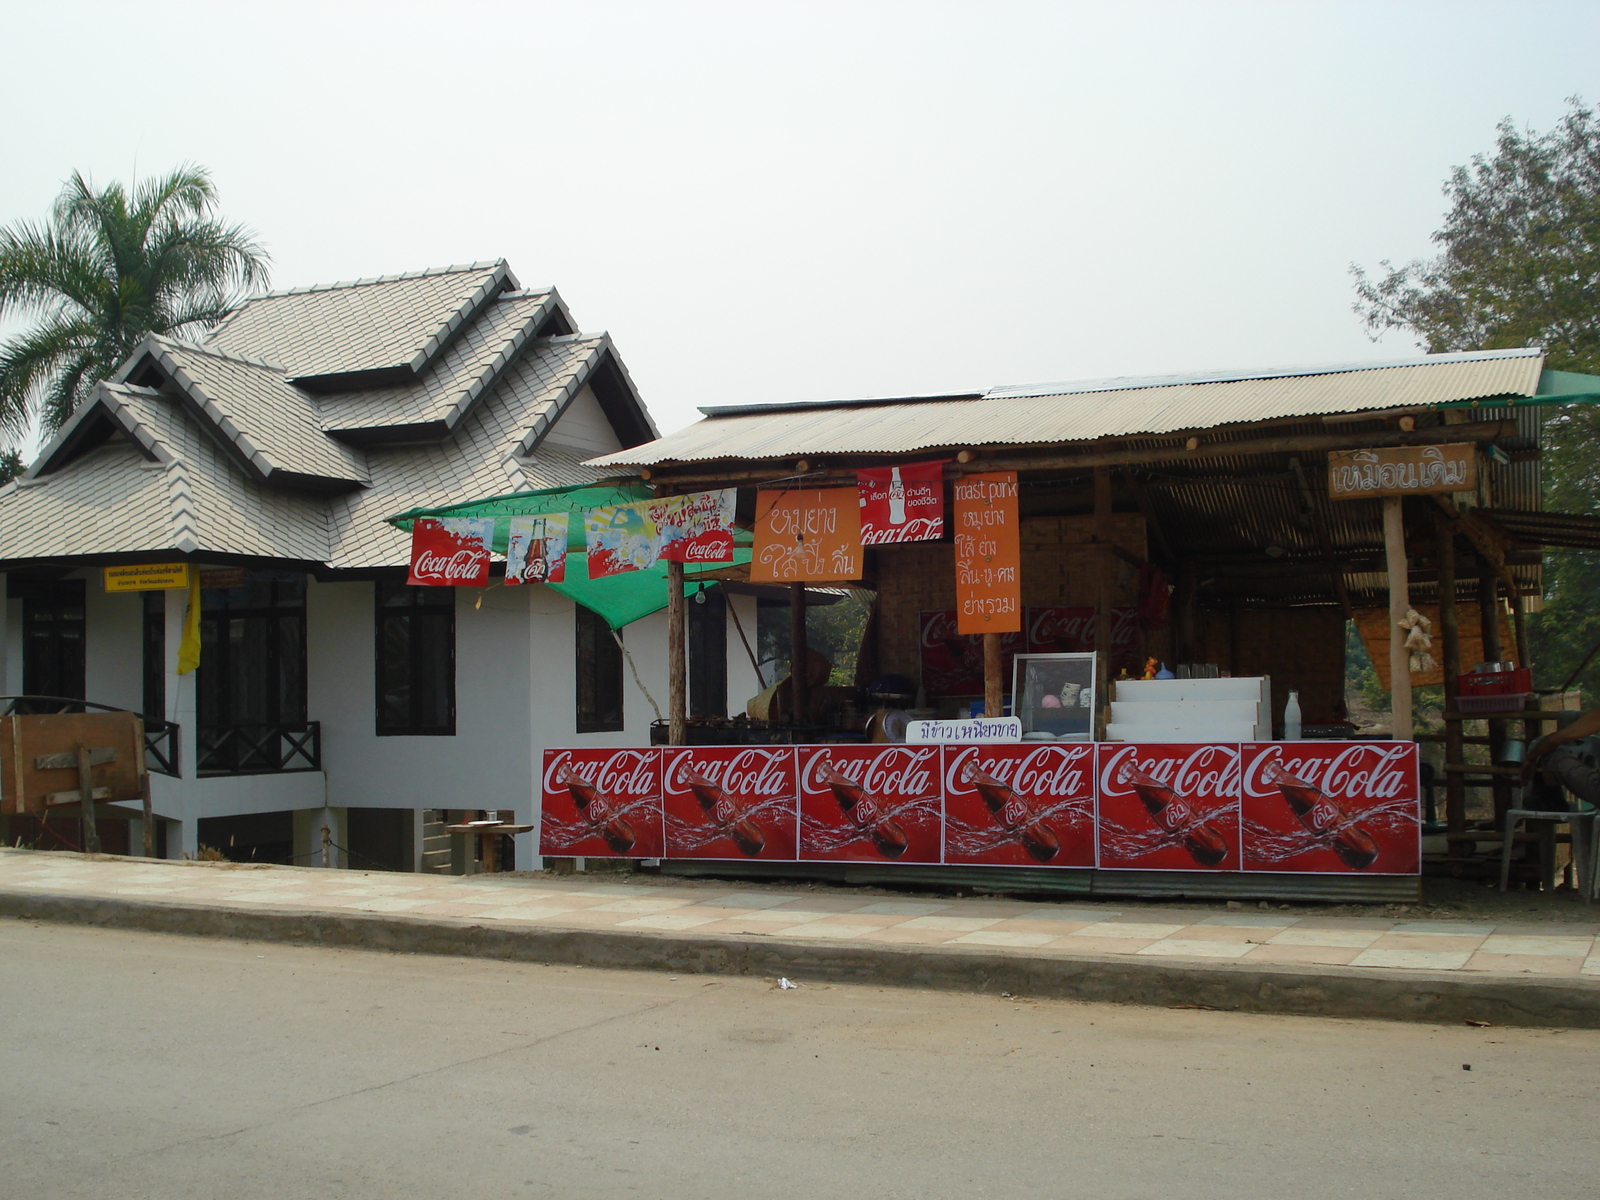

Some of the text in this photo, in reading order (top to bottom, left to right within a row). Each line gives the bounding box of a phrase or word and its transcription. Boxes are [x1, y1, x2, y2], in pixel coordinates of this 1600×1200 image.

[1333, 447, 1466, 492] เหมือนเดิม
[955, 481, 986, 500] roast
[414, 550, 485, 579] Coca-Cola
[685, 540, 730, 560] Coca-Cola
[1030, 609, 1138, 645] Cca-Cla
